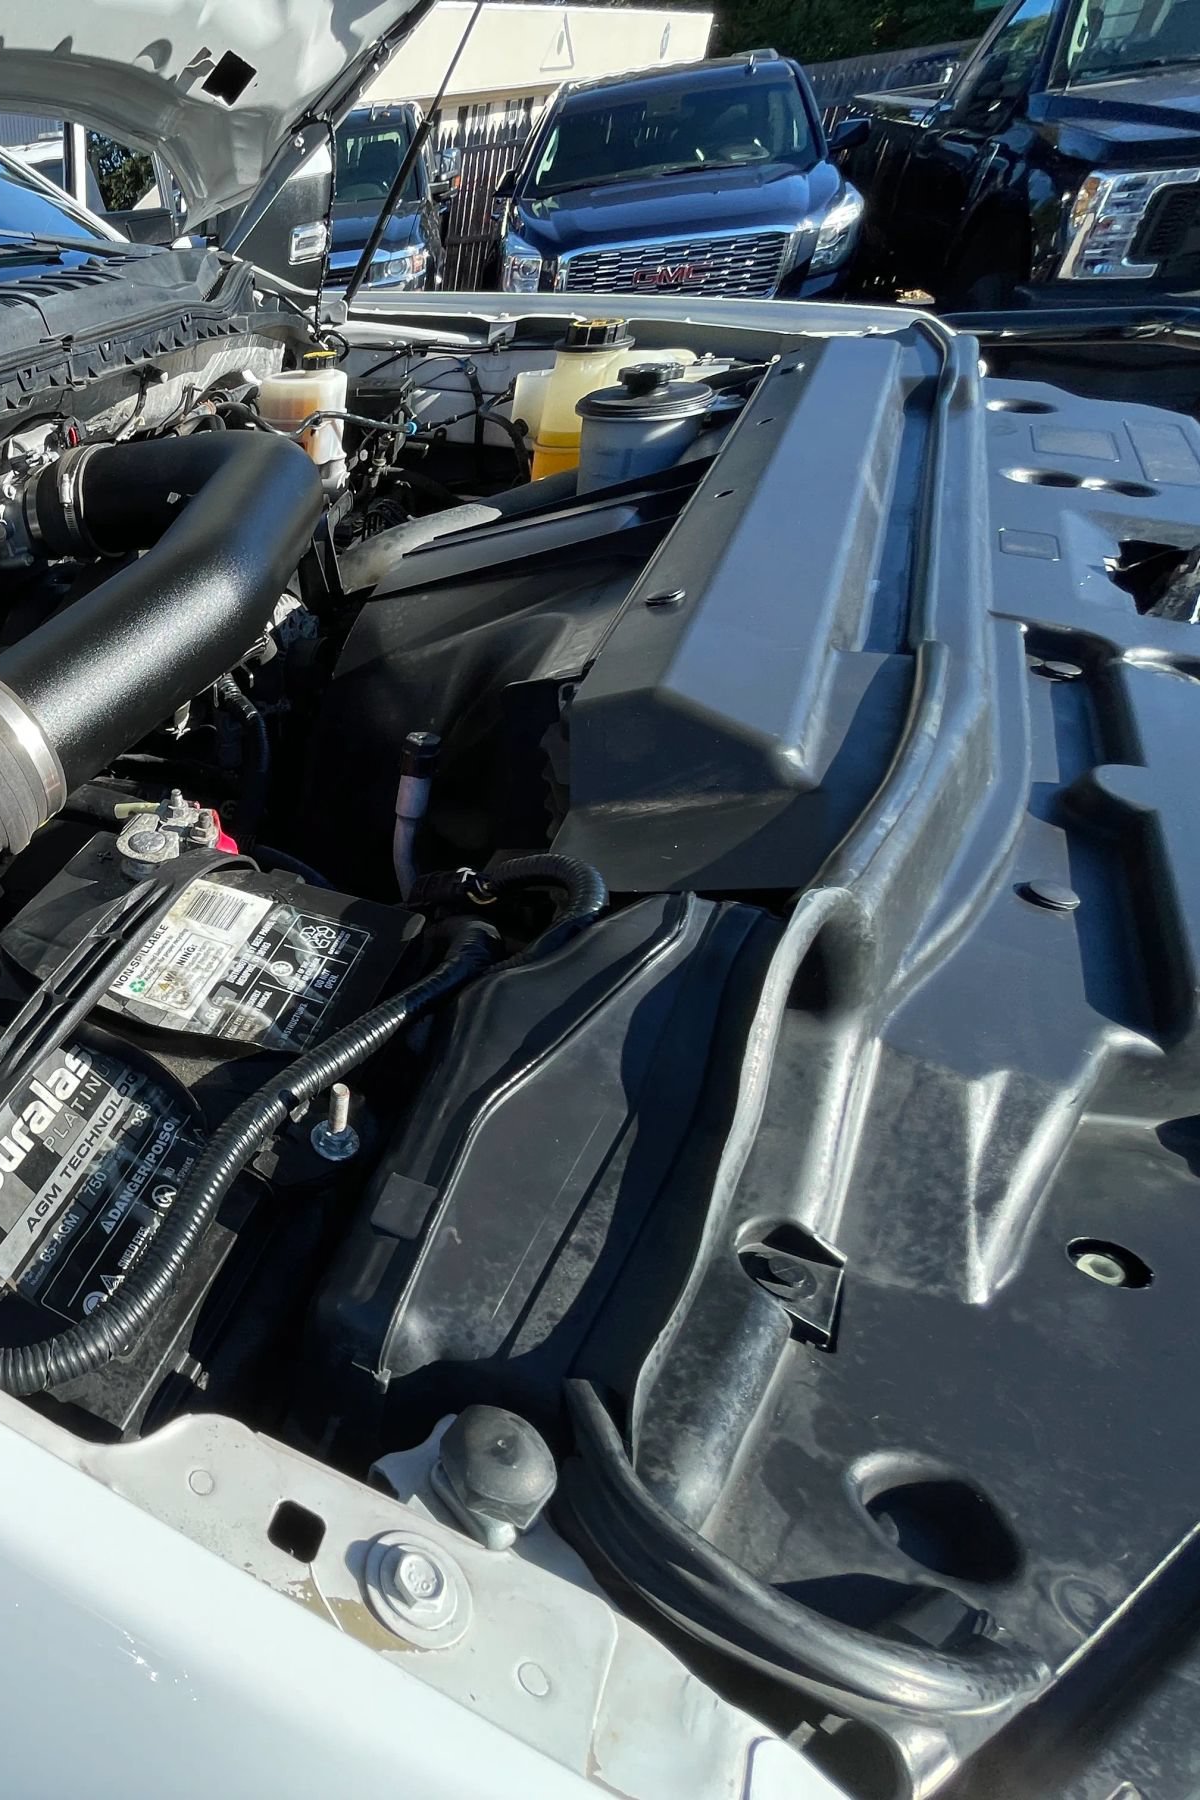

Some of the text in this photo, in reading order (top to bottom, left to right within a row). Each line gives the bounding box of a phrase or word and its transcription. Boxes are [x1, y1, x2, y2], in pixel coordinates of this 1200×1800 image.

[631, 261, 713, 288] GMC
[112, 924, 169, 989] NON-SPILLABLE
[164, 943, 198, 982] WANING:
[319, 968, 331, 980] NOT
[43, 1057, 118, 1153] PLATINU
[27, 1182, 63, 1234] AGM
[60, 1073, 139, 1179] TECHNOLOG
[40, 1102, 152, 1263] 65-AGM 750 935
[108, 1116, 181, 1222] DANGER/POISON
[117, 1243, 139, 1270] SHIELD
